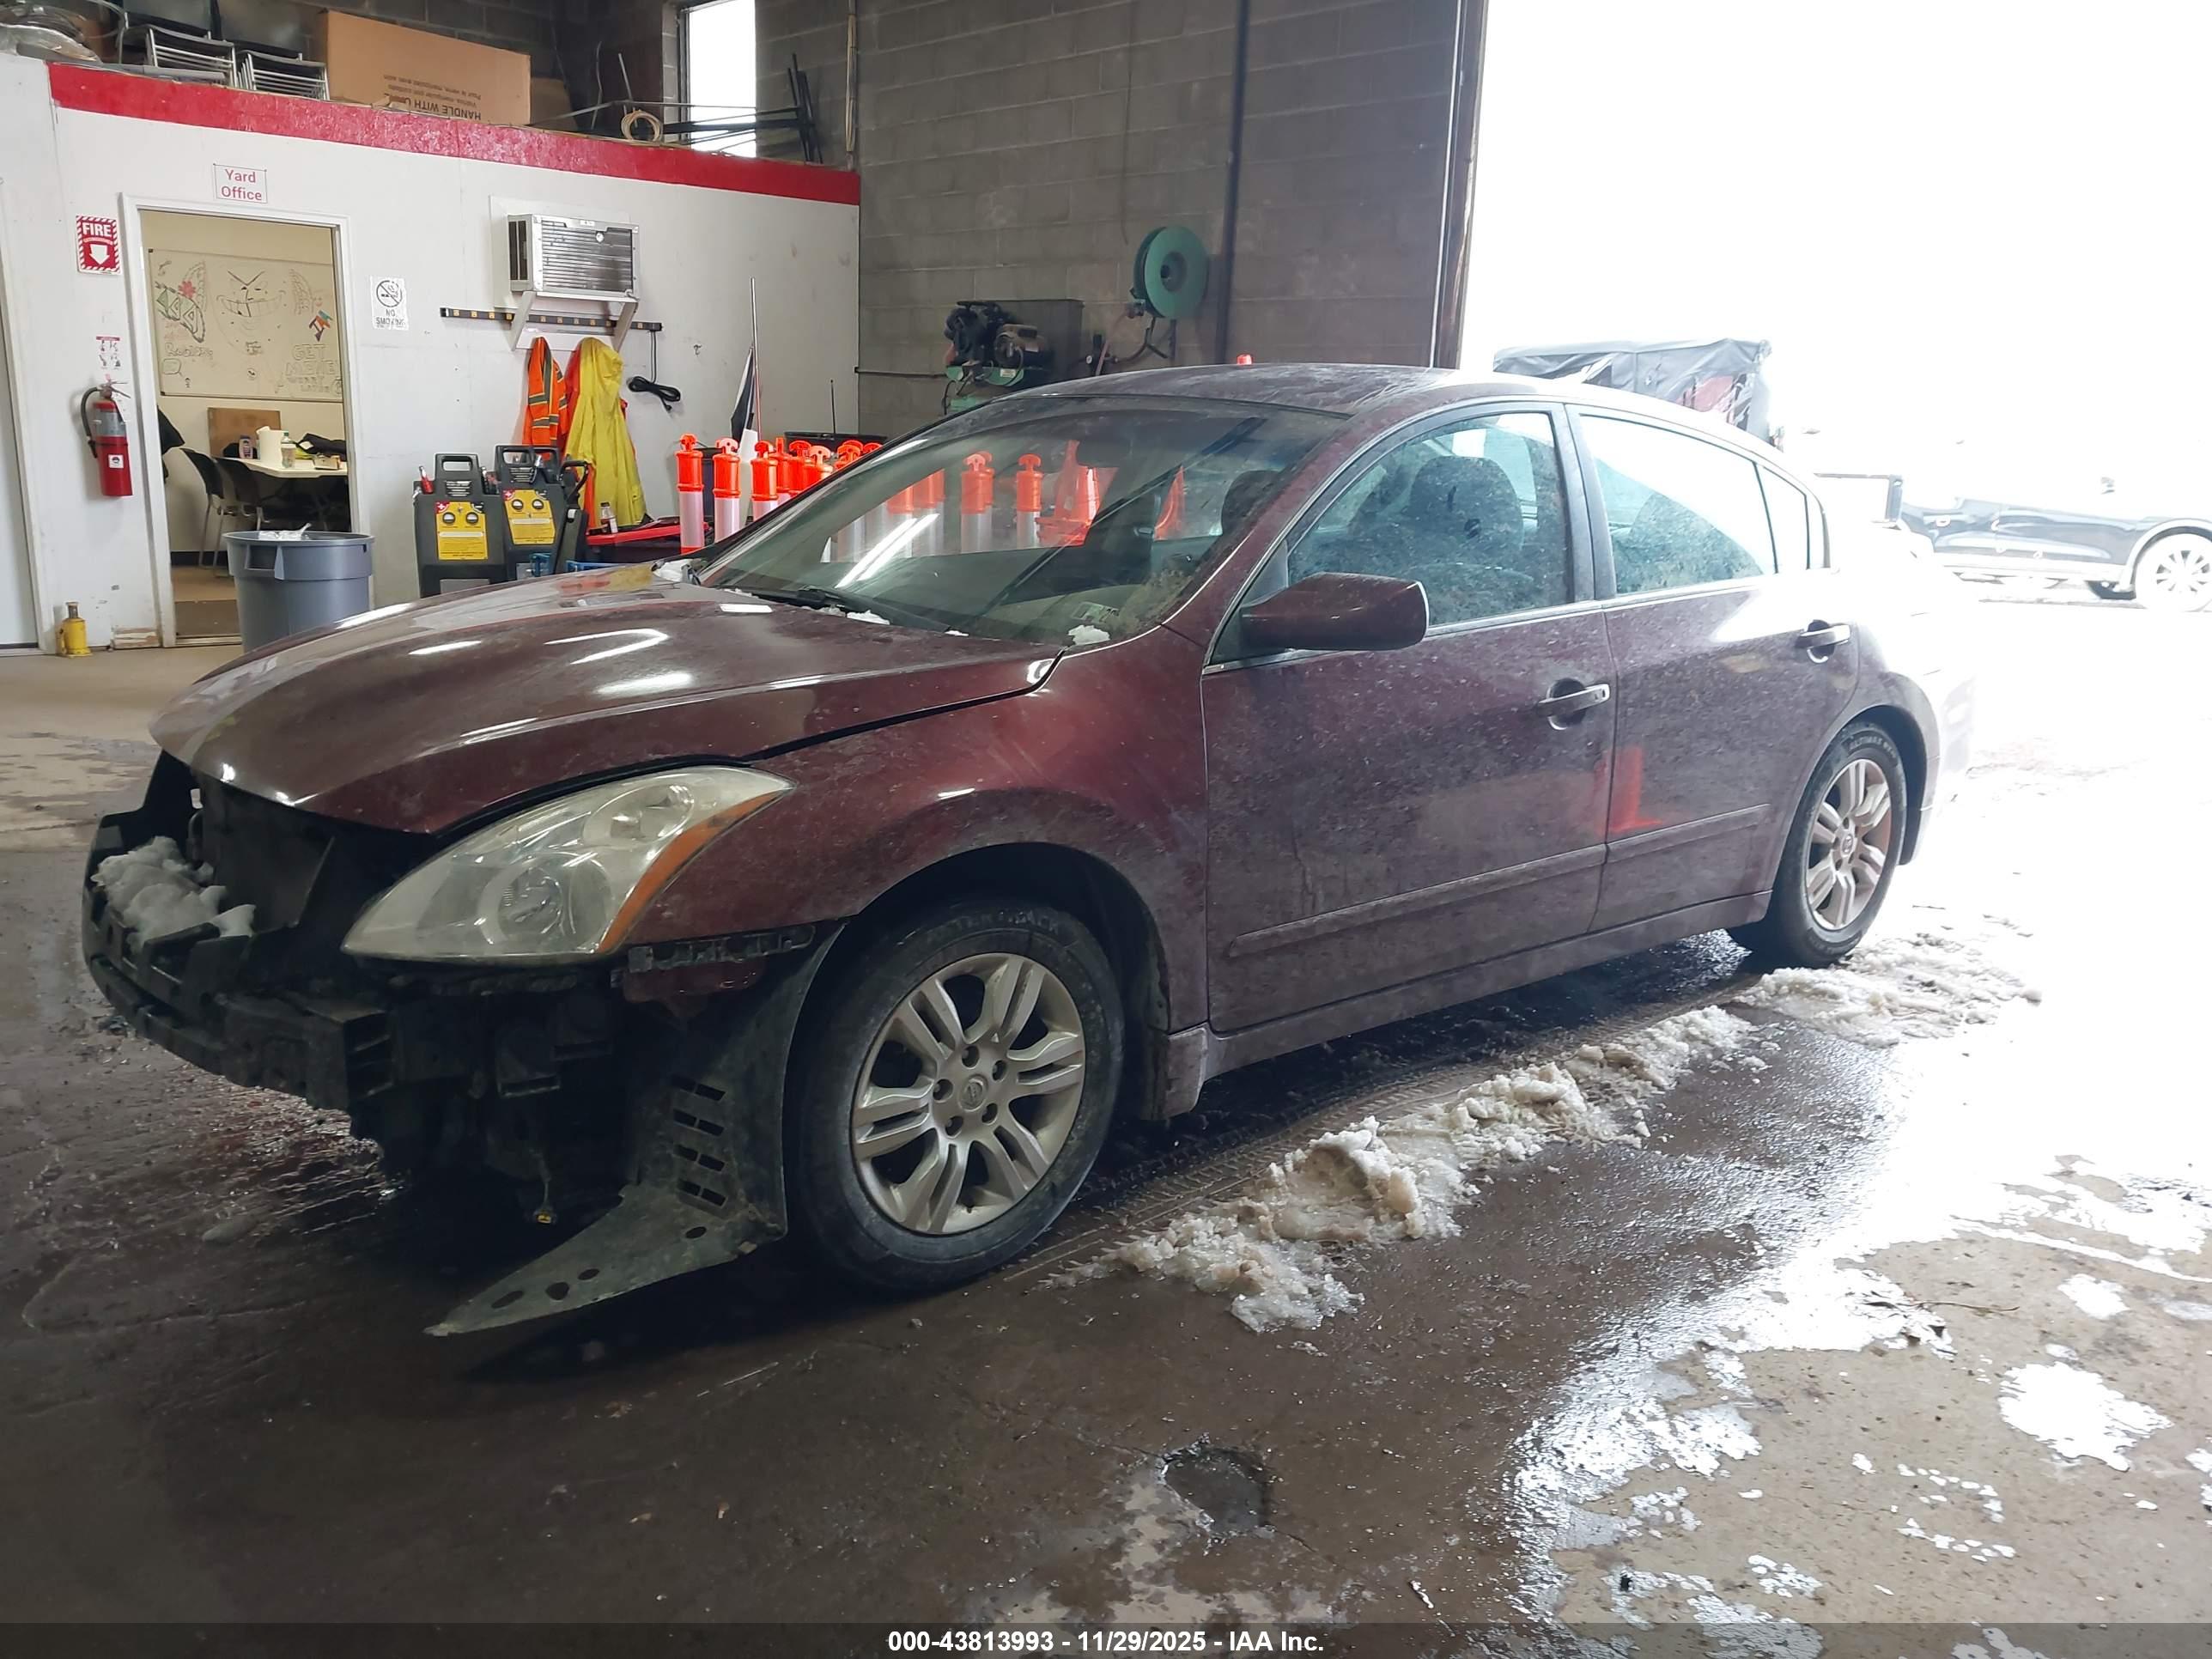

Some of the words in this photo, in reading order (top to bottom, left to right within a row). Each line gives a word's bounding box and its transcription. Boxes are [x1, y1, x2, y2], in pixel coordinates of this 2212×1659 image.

[414, 99, 440, 112] WITH
[441, 105, 482, 121] HANDLE
[225, 168, 256, 183] Yard
[221, 185, 262, 201] Office
[82, 222, 112, 237] FIRE
[386, 308, 396, 317] NO
